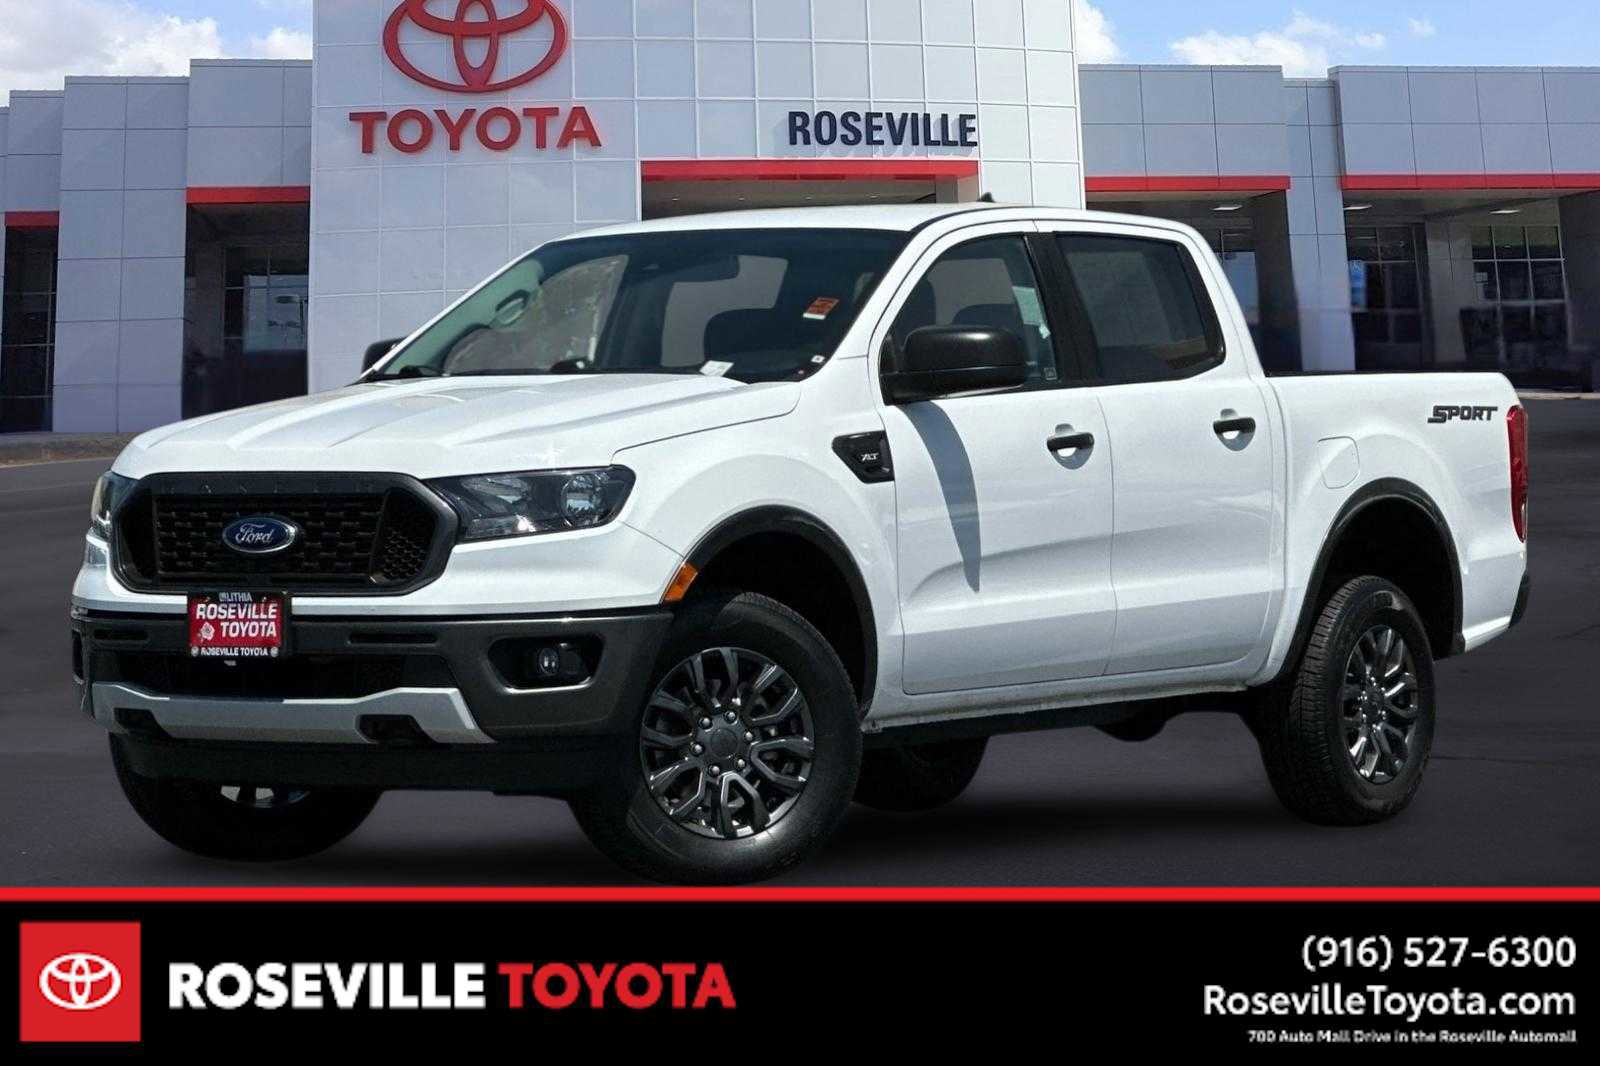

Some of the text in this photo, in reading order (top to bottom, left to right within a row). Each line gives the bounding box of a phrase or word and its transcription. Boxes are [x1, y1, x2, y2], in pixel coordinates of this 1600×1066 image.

[349, 106, 602, 154] TOYOTA
[787, 110, 978, 147] ROSEVILLE
[1427, 405, 1499, 423] SPORT
[235, 523, 275, 544] Ford
[226, 592, 253, 602] LITHIA
[195, 603, 278, 620] ROSEVILLE
[220, 621, 277, 637] TOYOTA
[200, 647, 268, 656] ROSEVILLE TOYOTA
